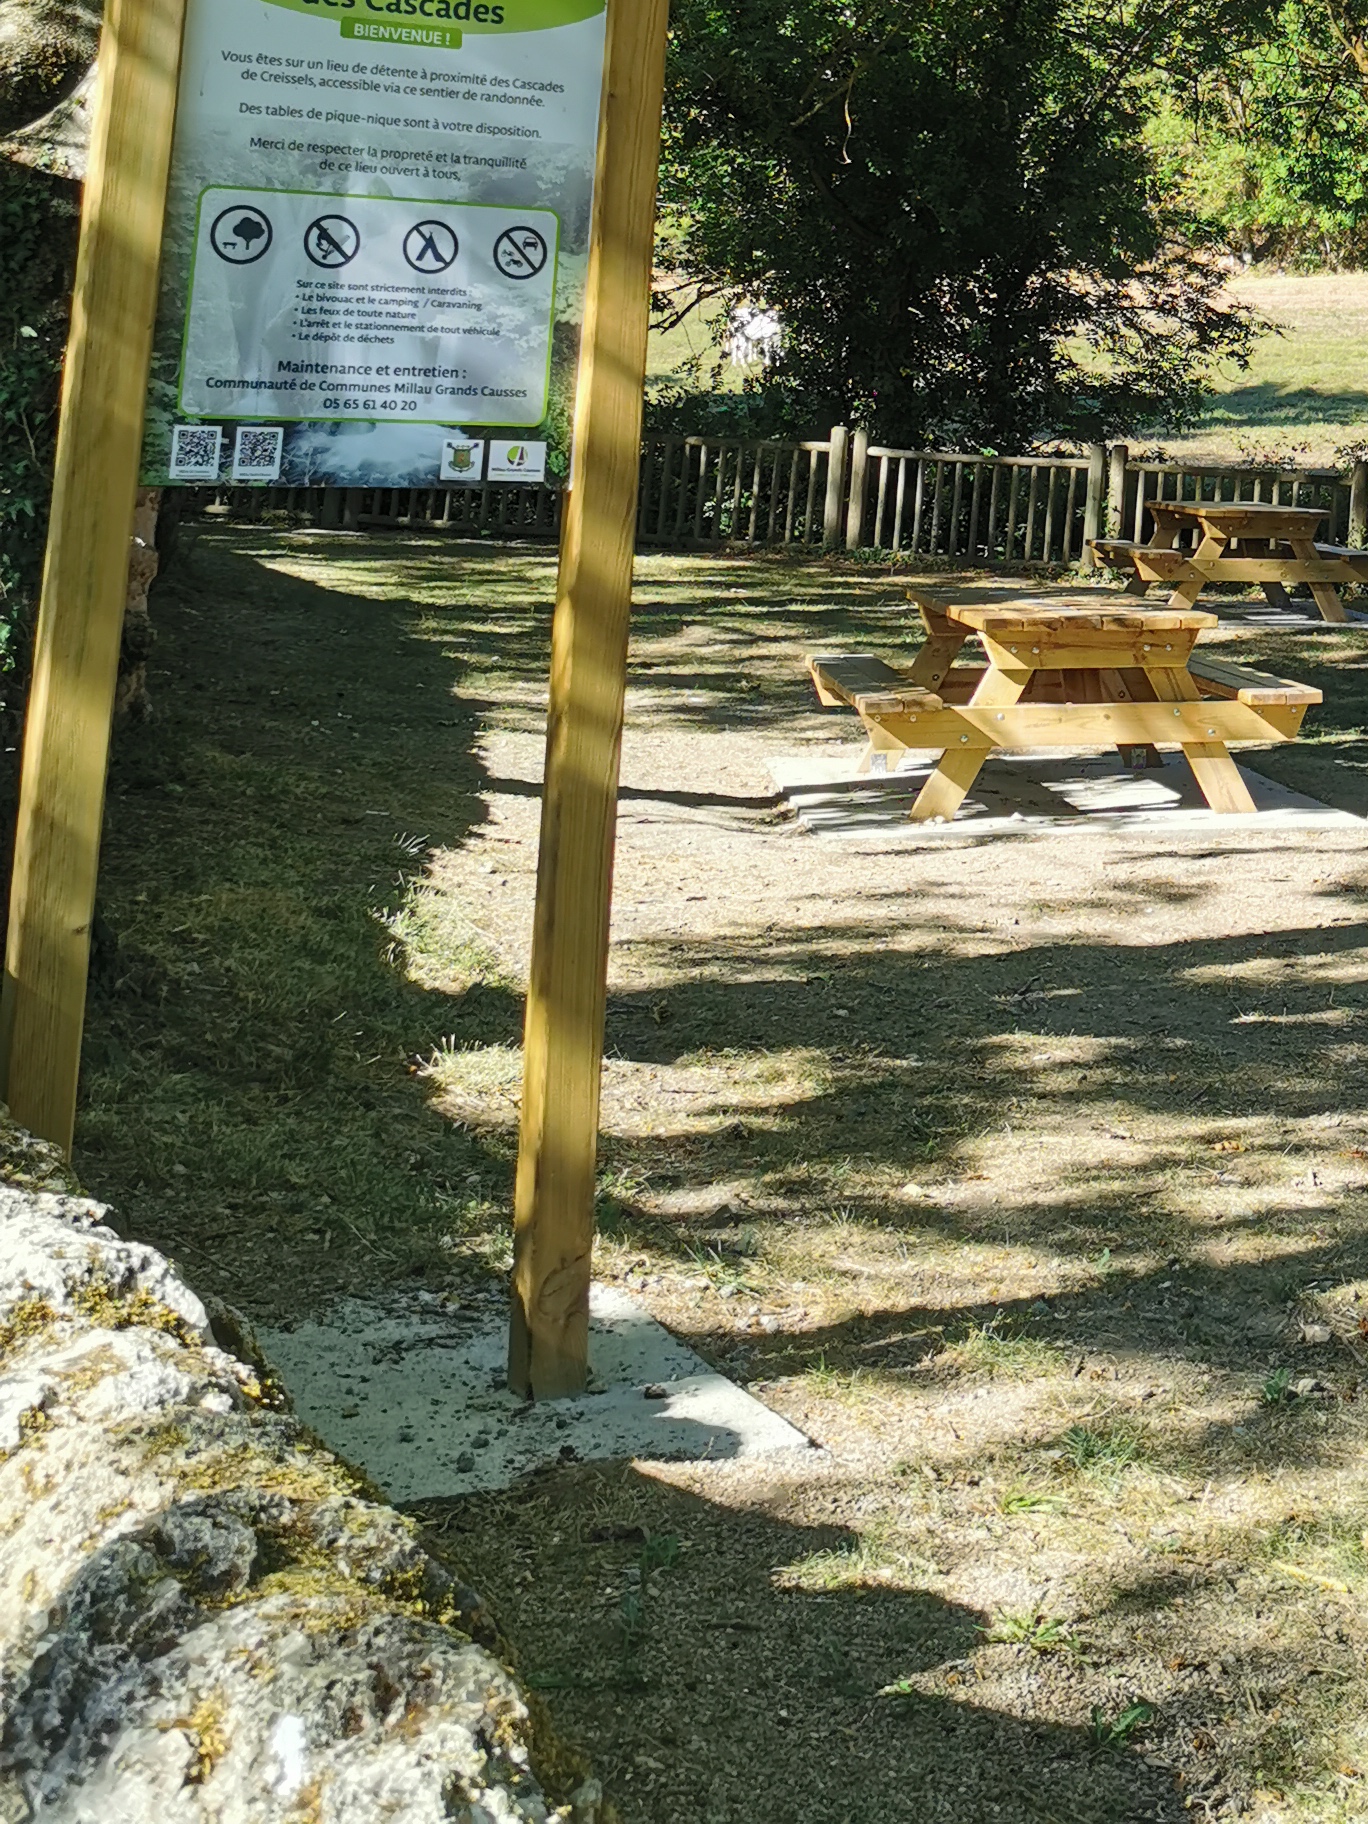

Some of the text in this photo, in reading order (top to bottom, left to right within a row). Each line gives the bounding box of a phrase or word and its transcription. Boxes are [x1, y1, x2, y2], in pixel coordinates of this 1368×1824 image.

[354, 24, 442, 45] BIENVENUE
[221, 50, 565, 94] Vous êtes sur un lieu de détente à proximité des Cascades
[240, 69, 546, 108] de Creissels, accessible via ce sentier de randonnée.
[239, 102, 542, 139] Des tables de pique-nique sont à votre disposition.
[250, 137, 527, 170] Merci de respecter la propreté et la tranquillité
[319, 159, 335, 171] de
[338, 162, 352, 172] ce
[355, 161, 377, 173] lieu
[380, 166, 420, 175] ouvert
[422, 166, 430, 178] à
[296, 279, 313, 288] Sur
[314, 281, 326, 290] ce
[328, 281, 345, 290] site
[347, 283, 369, 291] sont
[371, 283, 426, 294] strictement
[427, 287, 467, 296] interdits
[302, 293, 314, 302] Le
[356, 295, 366, 304] et
[367, 296, 377, 305] le
[378, 297, 420, 309] camping
[430, 299, 483, 312] Caravaning
[301, 306, 417, 320] Les feux de toute nature
[332, 320, 341, 329] et
[343, 321, 353, 330] le
[354, 322, 425, 333] stationnement
[427, 325, 439, 333] de
[440, 326, 461, 334] tout
[298, 332, 310, 341] Le
[343, 334, 355, 343] de
[357, 334, 395, 344] déchets
[277, 360, 373, 375] Maintenance
[376, 365, 390, 376] et
[393, 365, 459, 379] entretien
[206, 377, 528, 398] Communauté de Communes Millau Grands Causses
[323, 398, 417, 411] 05 65 61 40 20
